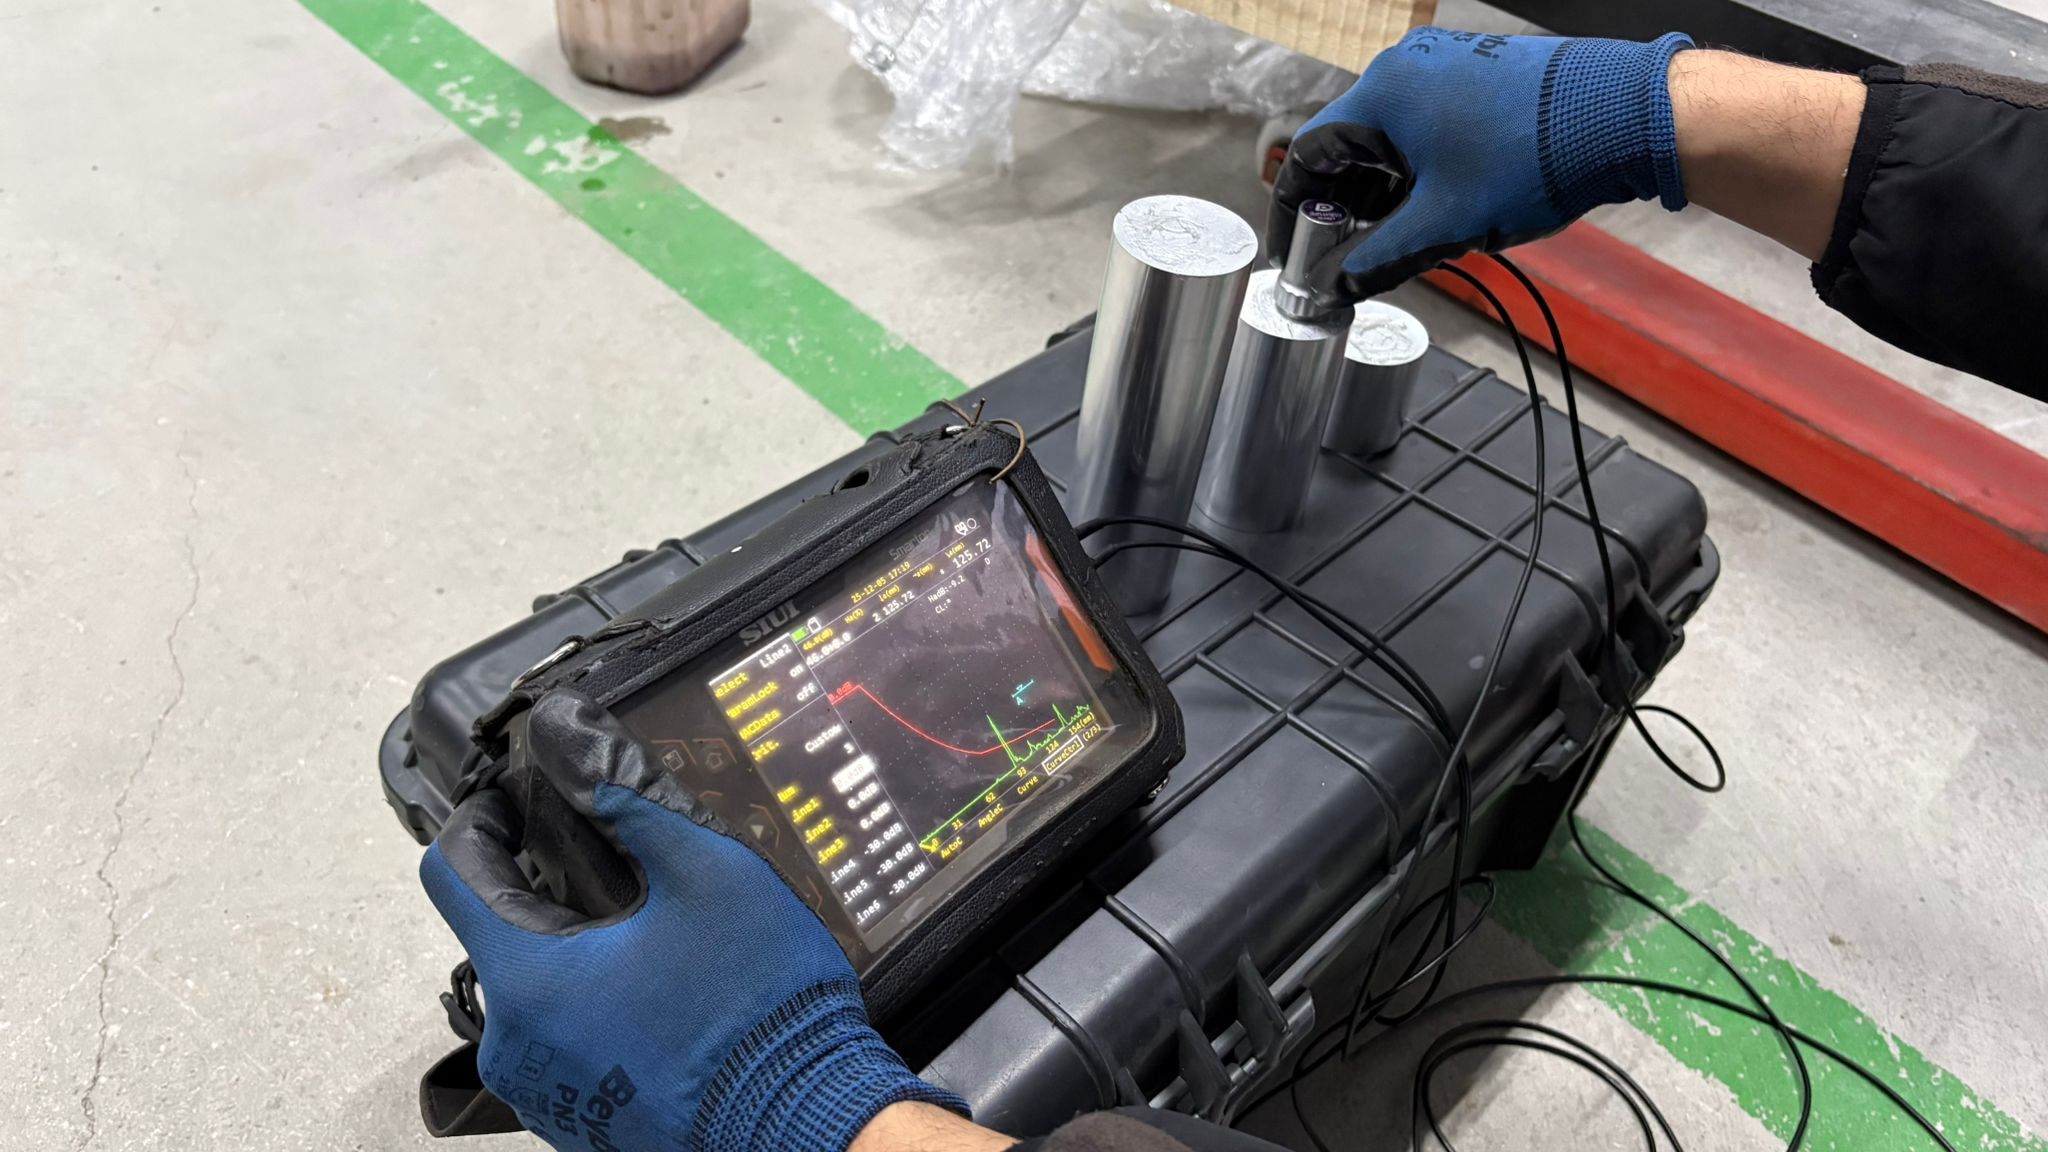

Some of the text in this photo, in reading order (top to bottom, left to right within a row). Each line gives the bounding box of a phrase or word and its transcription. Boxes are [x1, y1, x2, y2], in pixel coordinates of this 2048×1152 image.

[851, 561, 911, 603] 25-12-05 17:19
[882, 590, 915, 616] 125.72
[952, 538, 991, 568] 125.72
[739, 602, 800, 647] SIUI
[759, 643, 793, 669] Line2
[789, 664, 804, 678] on
[796, 682, 817, 701] off
[792, 798, 820, 824] ine1
[805, 782, 878, 844] ine2 0.0dB
[940, 723, 1101, 859] AutoC AngleC Curve CurveCtrl (2/3)
[951, 819, 964, 831] 31
[985, 792, 996, 803] 62
[1016, 766, 1027, 778] 93
[1045, 741, 1060, 754] 124
[818, 802, 891, 864] ine3 0.0dB
[832, 822, 903, 885] ine4 -30.0dB
[844, 843, 915, 905] ine5 -30.0dB
[857, 899, 881, 926] ine6
[552, 1082, 580, 1137] PN3
